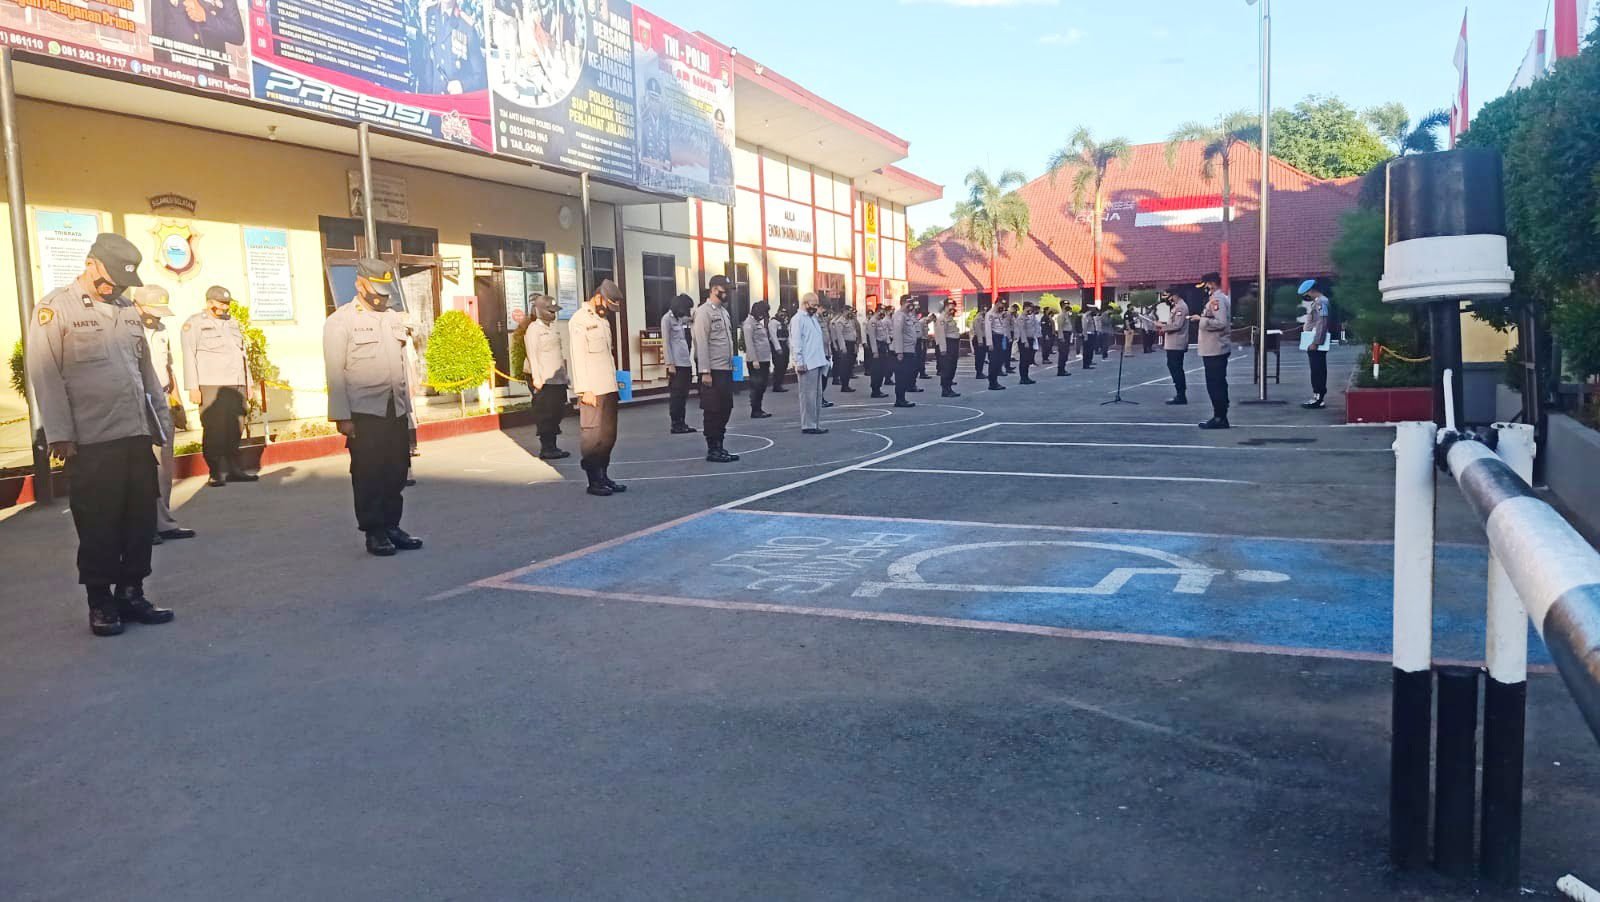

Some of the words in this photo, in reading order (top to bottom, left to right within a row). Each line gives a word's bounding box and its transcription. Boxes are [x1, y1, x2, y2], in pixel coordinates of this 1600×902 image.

[40, 0, 101, 23] Pelayanan
[102, 10, 135, 32] Prima
[609, 11, 631, 36] MARI
[593, 19, 632, 52] BERSAMA
[588, 49, 633, 83] KEJAHATAN
[597, 38, 632, 68] PERANGI
[265, 71, 431, 126] PRESISI
[597, 71, 634, 99] JALANAN
[571, 96, 589, 113] SIAP
[589, 101, 615, 121] TINDAK
[614, 111, 635, 128] TEGAS
[588, 89, 615, 109] POLRES
[615, 99, 635, 116] GOWA
[72, 320, 99, 328] HATTA
